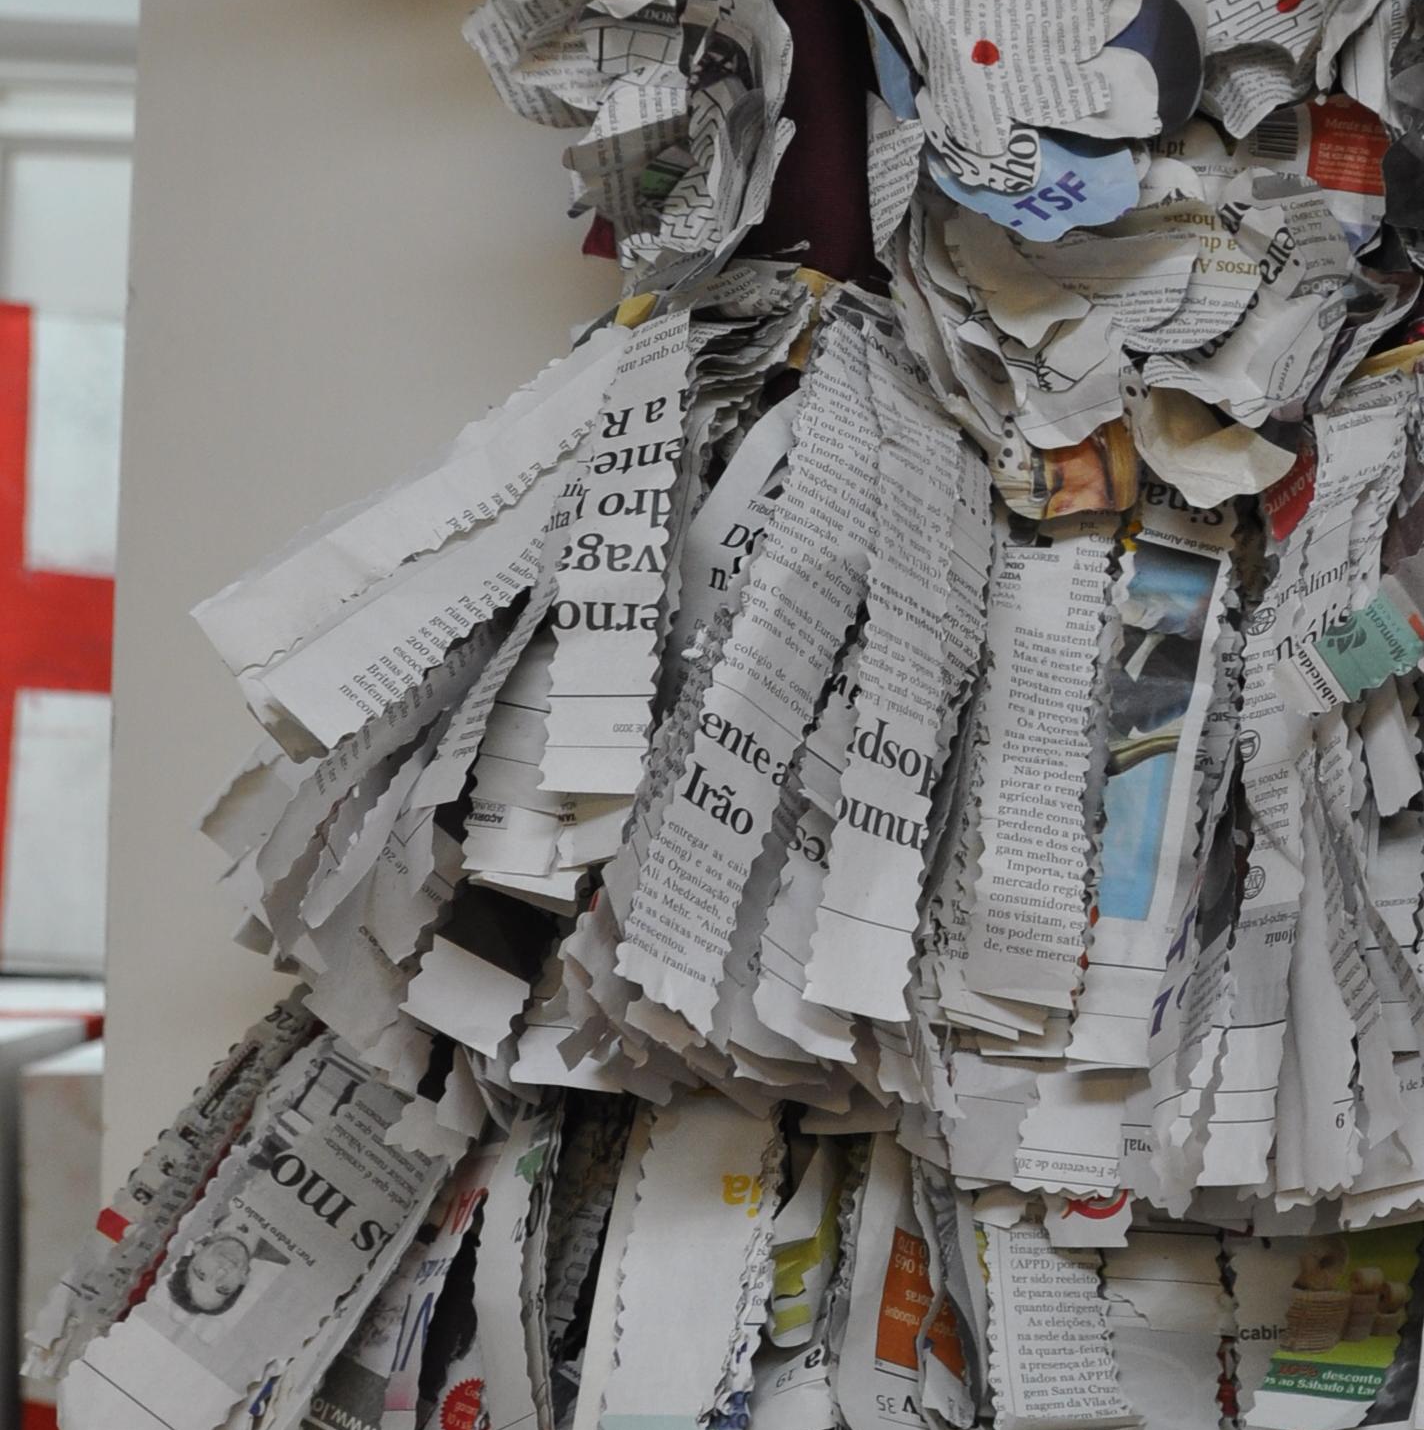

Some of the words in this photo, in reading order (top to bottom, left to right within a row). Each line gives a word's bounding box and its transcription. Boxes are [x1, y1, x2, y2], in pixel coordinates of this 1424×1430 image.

[1009, 687, 1060, 708] produtos
[681, 761, 755, 836] Irão
[999, 791, 1058, 812] agrícolas
[997, 804, 1043, 822] grande
[666, 820, 710, 852] entregar
[996, 817, 1060, 839] perdendo
[1022, 845, 1072, 867] melhor
[667, 858, 731, 907] Organização
[992, 874, 1050, 895] mercado
[987, 905, 1009, 920] nos
[1009, 926, 1057, 946] podem
[1010, 1258, 1055, 1271] (APPD)
[1011, 1274, 1028, 1285] ter
[1030, 1273, 1055, 1285] sido
[1056, 1273, 1098, 1285] reeleito
[1014, 1302, 1055, 1316] quanto
[1045, 1317, 1096, 1331] eleições,
[1034, 1331, 1060, 1342] sede
[1028, 1359, 1080, 1373] presença
[1297, 1376, 1344, 1395] Sábado
[1322, 1369, 1382, 1385] desconto
[1051, 1385, 1086, 1398] Santa
[1082, 1396, 1106, 1408] Vila
